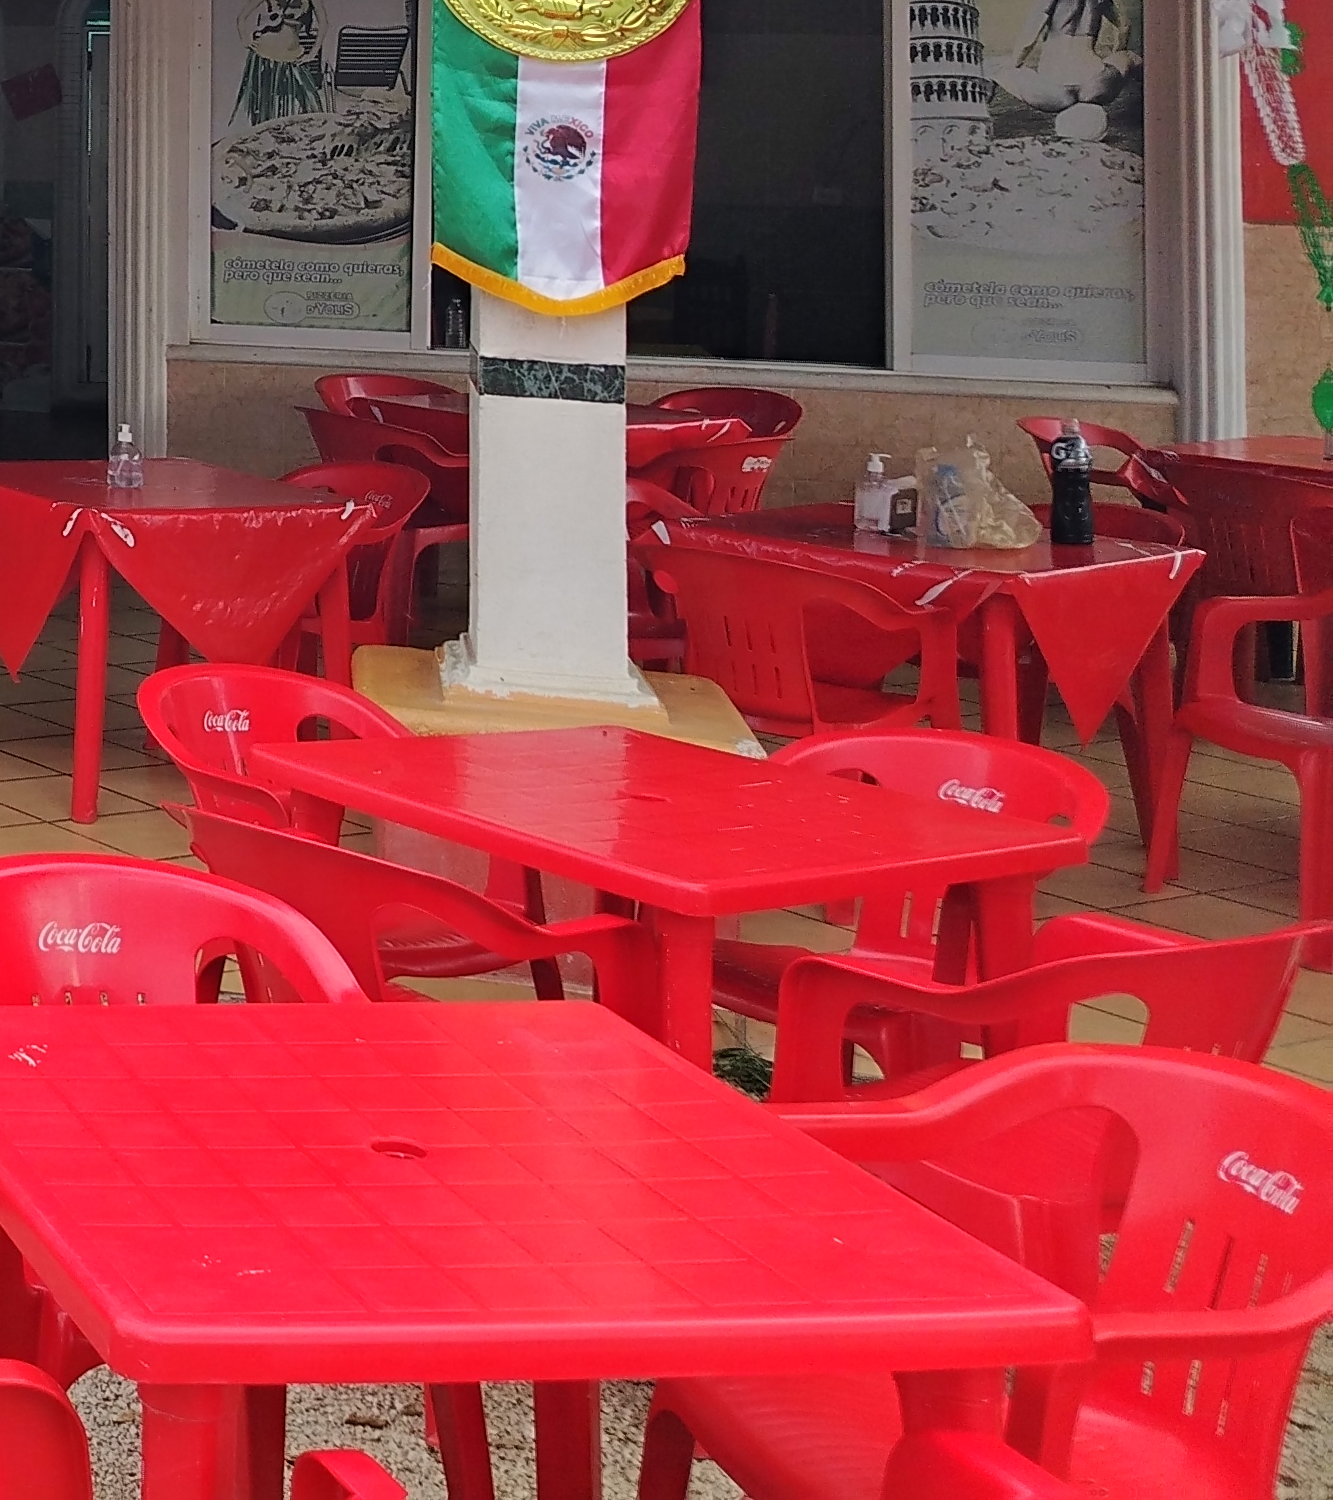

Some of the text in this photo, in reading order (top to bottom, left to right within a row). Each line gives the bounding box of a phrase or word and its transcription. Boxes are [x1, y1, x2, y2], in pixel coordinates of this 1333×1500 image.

[525, 117, 549, 136] VIVA
[297, 260, 339, 272] como
[223, 269, 259, 283] pero
[1011, 285, 1059, 297] como
[204, 709, 250, 732] Coca-Cola
[38, 921, 121, 953] Coca-Cola
